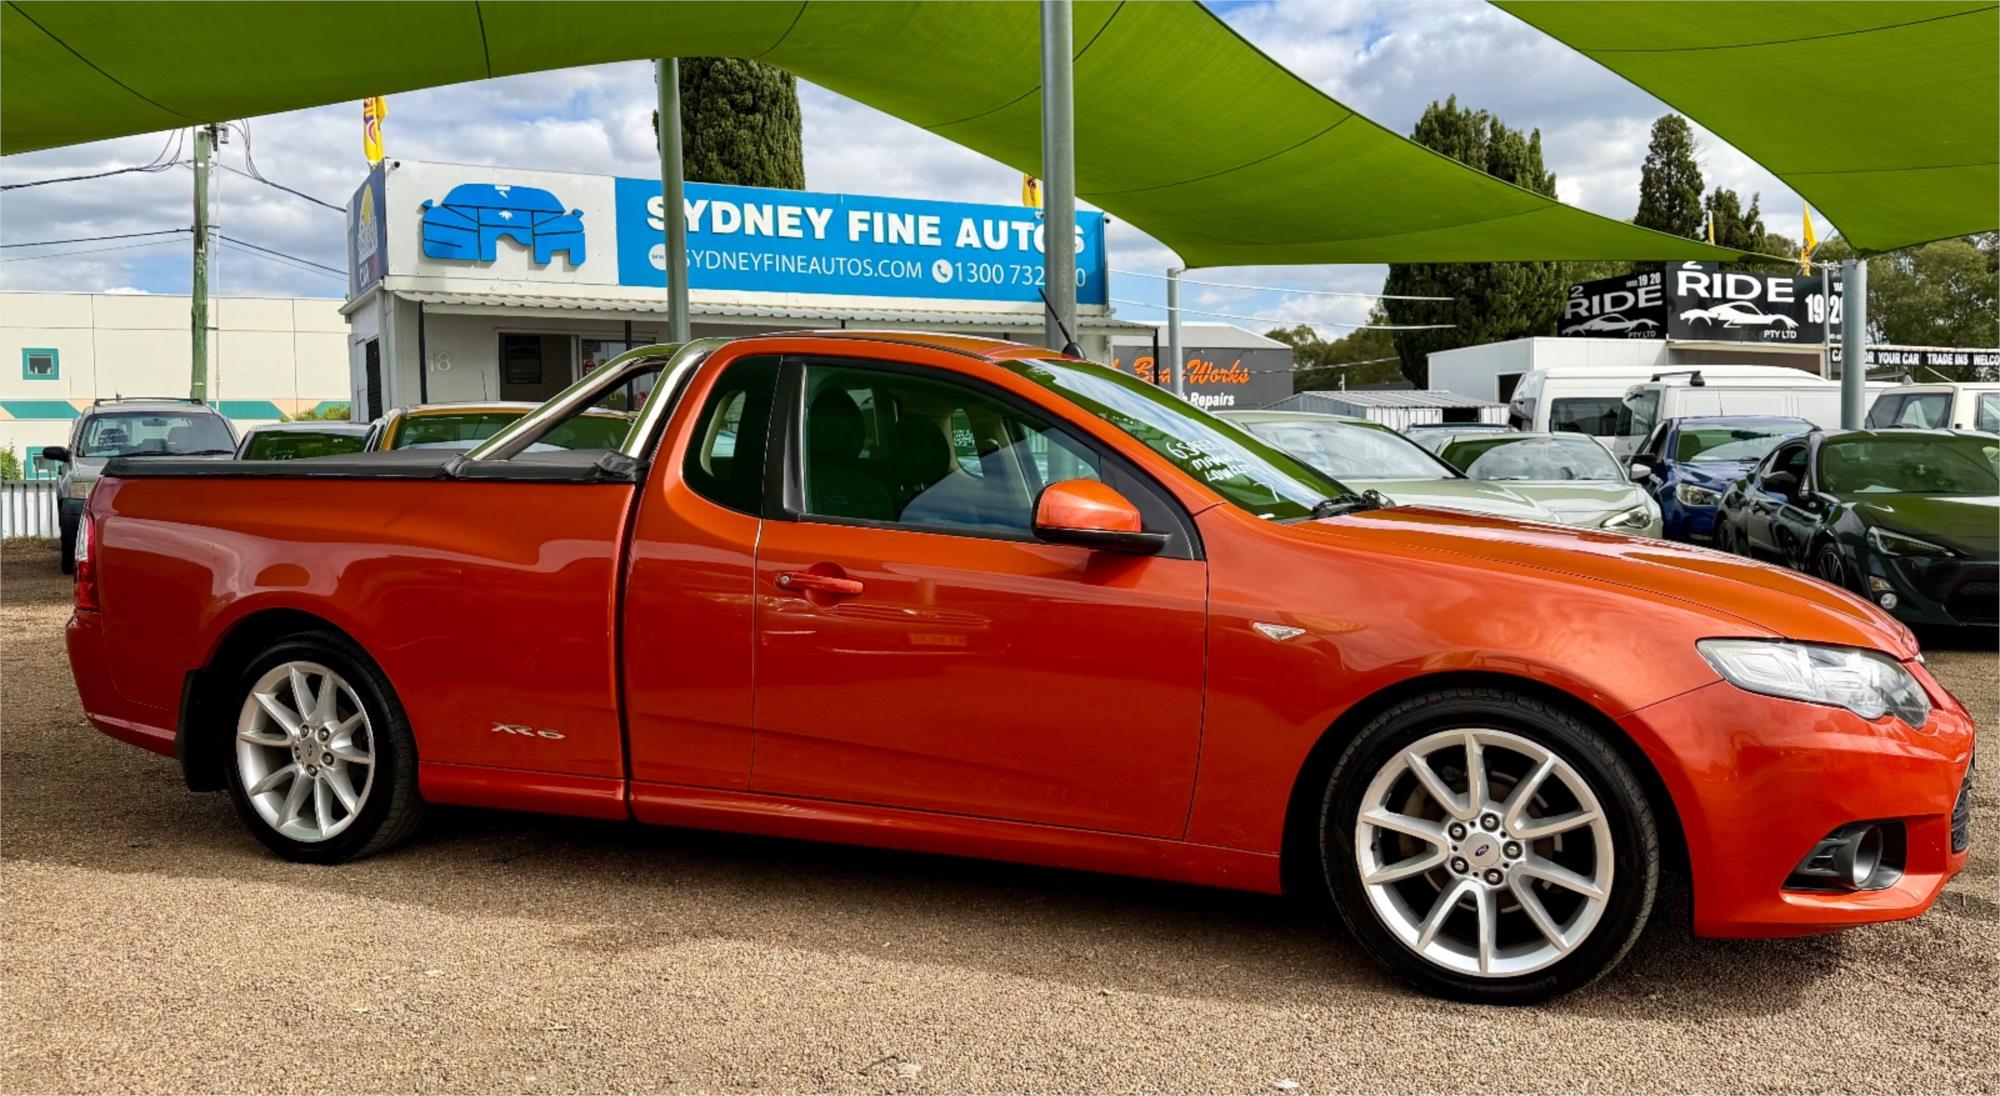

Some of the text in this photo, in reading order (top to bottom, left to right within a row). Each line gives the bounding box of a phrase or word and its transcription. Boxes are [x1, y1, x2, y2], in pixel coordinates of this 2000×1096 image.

[646, 195, 834, 240] SYDNEY
[848, 210, 942, 247] FINE
[954, 261, 1046, 286] 1300 732
[1649, 271, 1661, 285] 20
[1570, 285, 1584, 298] 2
[1677, 270, 1796, 304] RIDE
[1564, 284, 1664, 320] RIDE
[1763, 329, 1797, 340] PTY LTD
[1877, 352, 1901, 365] YOUR
[1901, 352, 1920, 365] CAR
[1926, 353, 1953, 366] TRADE
[1186, 359, 1250, 385] Works
[1190, 391, 1236, 410] Repairs
